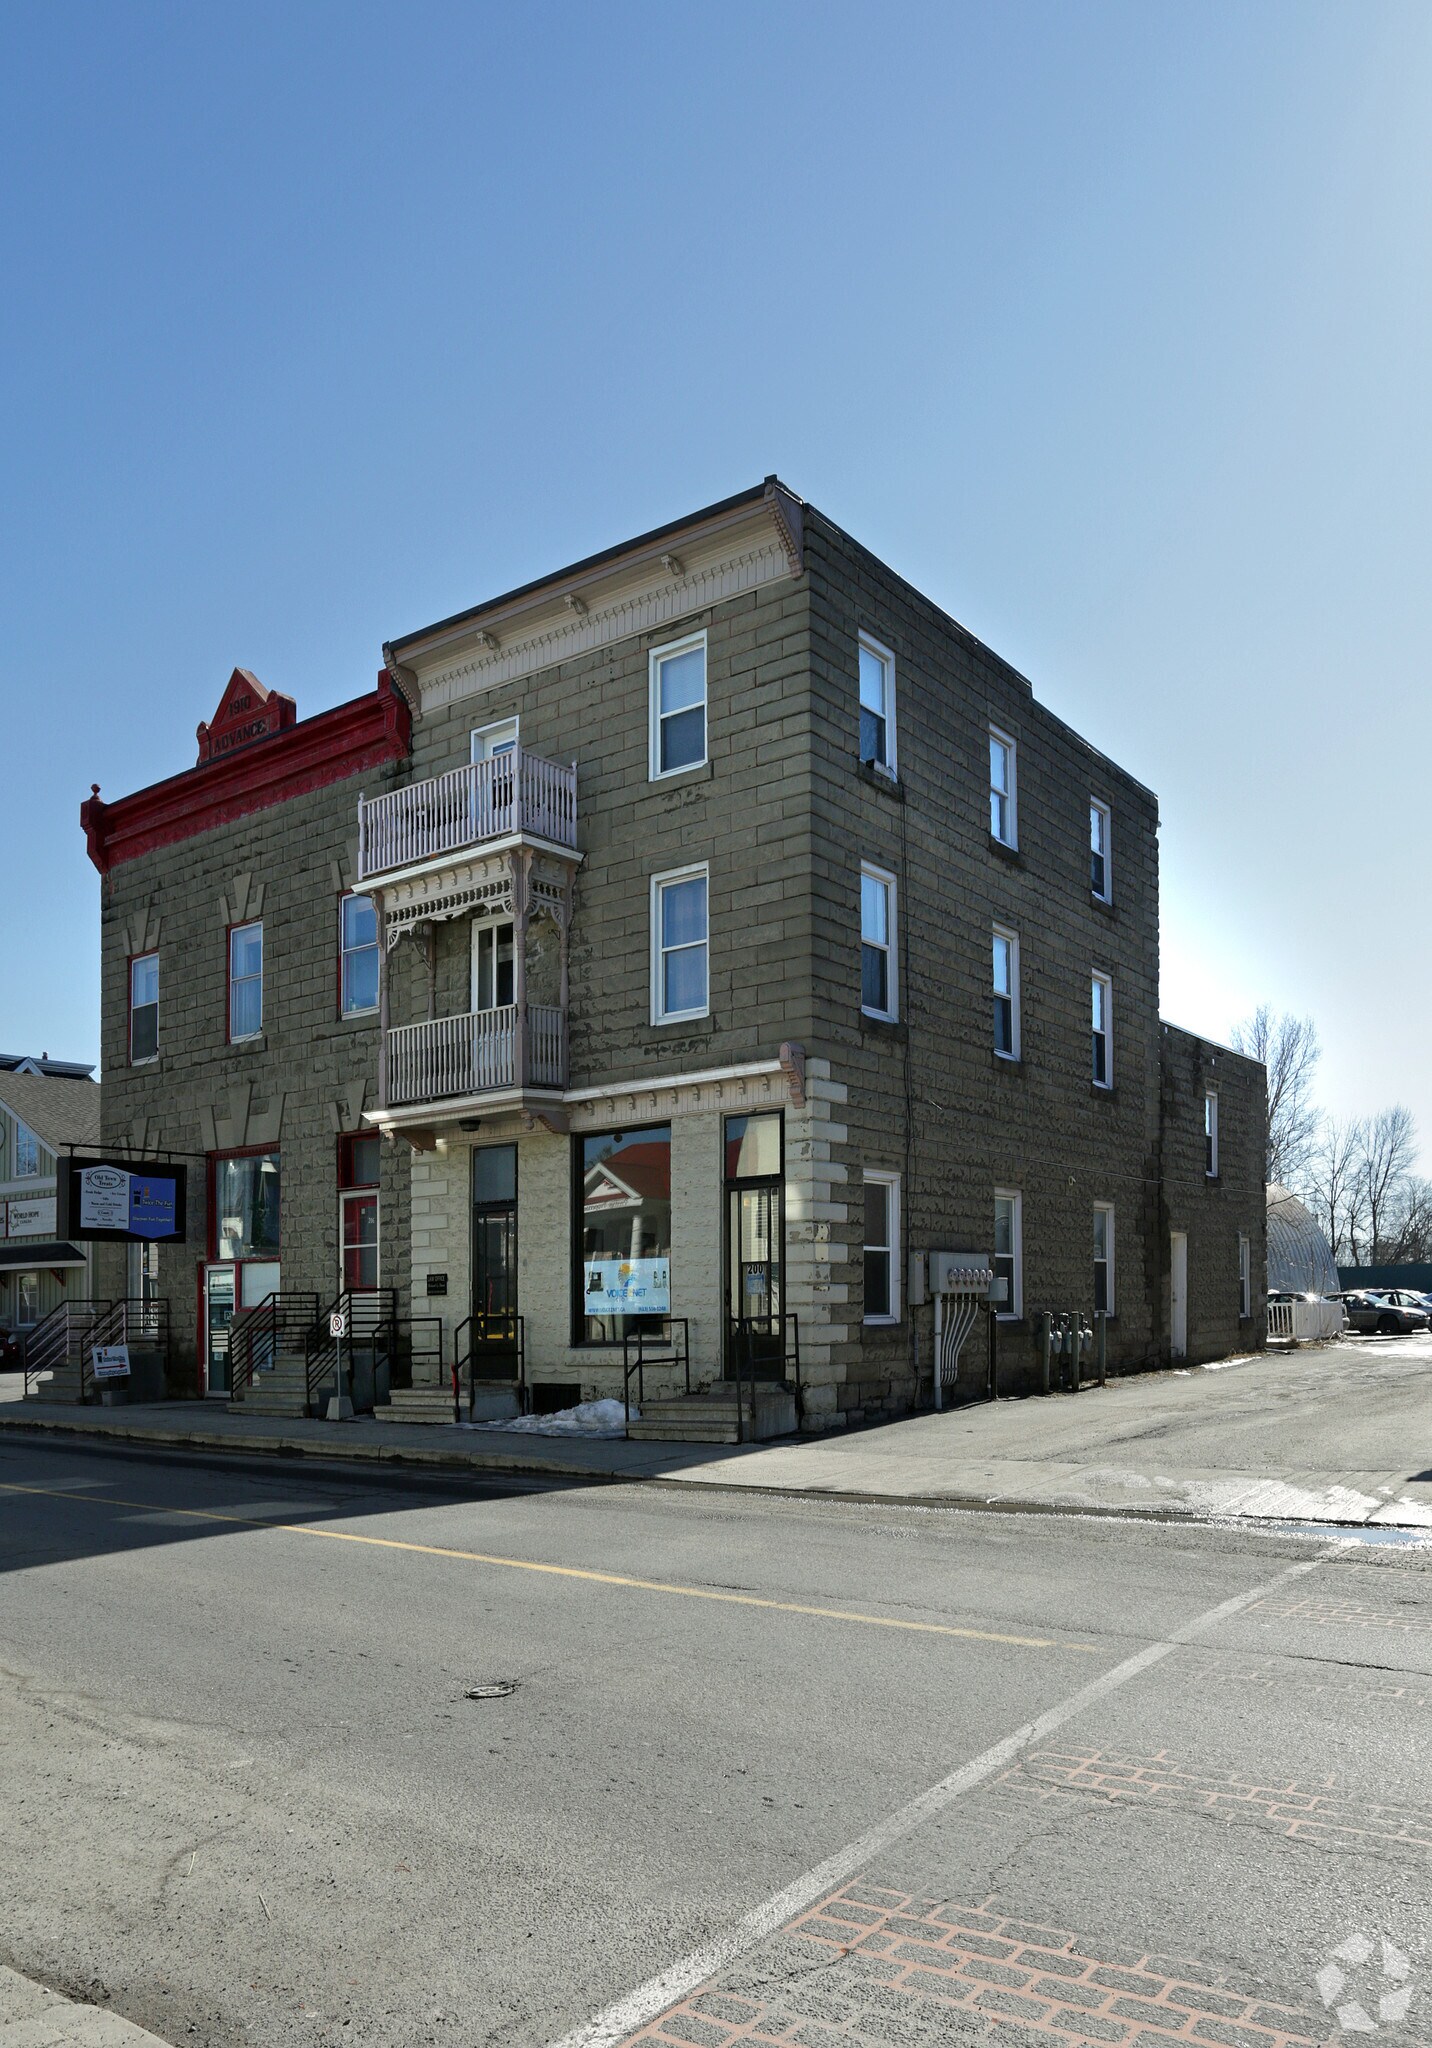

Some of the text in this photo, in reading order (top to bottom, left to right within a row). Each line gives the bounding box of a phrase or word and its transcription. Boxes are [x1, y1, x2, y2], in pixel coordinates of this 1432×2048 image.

[229, 695, 251, 716] 1910
[213, 718, 267, 753] ADVANCE
[14, 1211, 28, 1219] WORLD
[748, 1264, 763, 1275] 200
